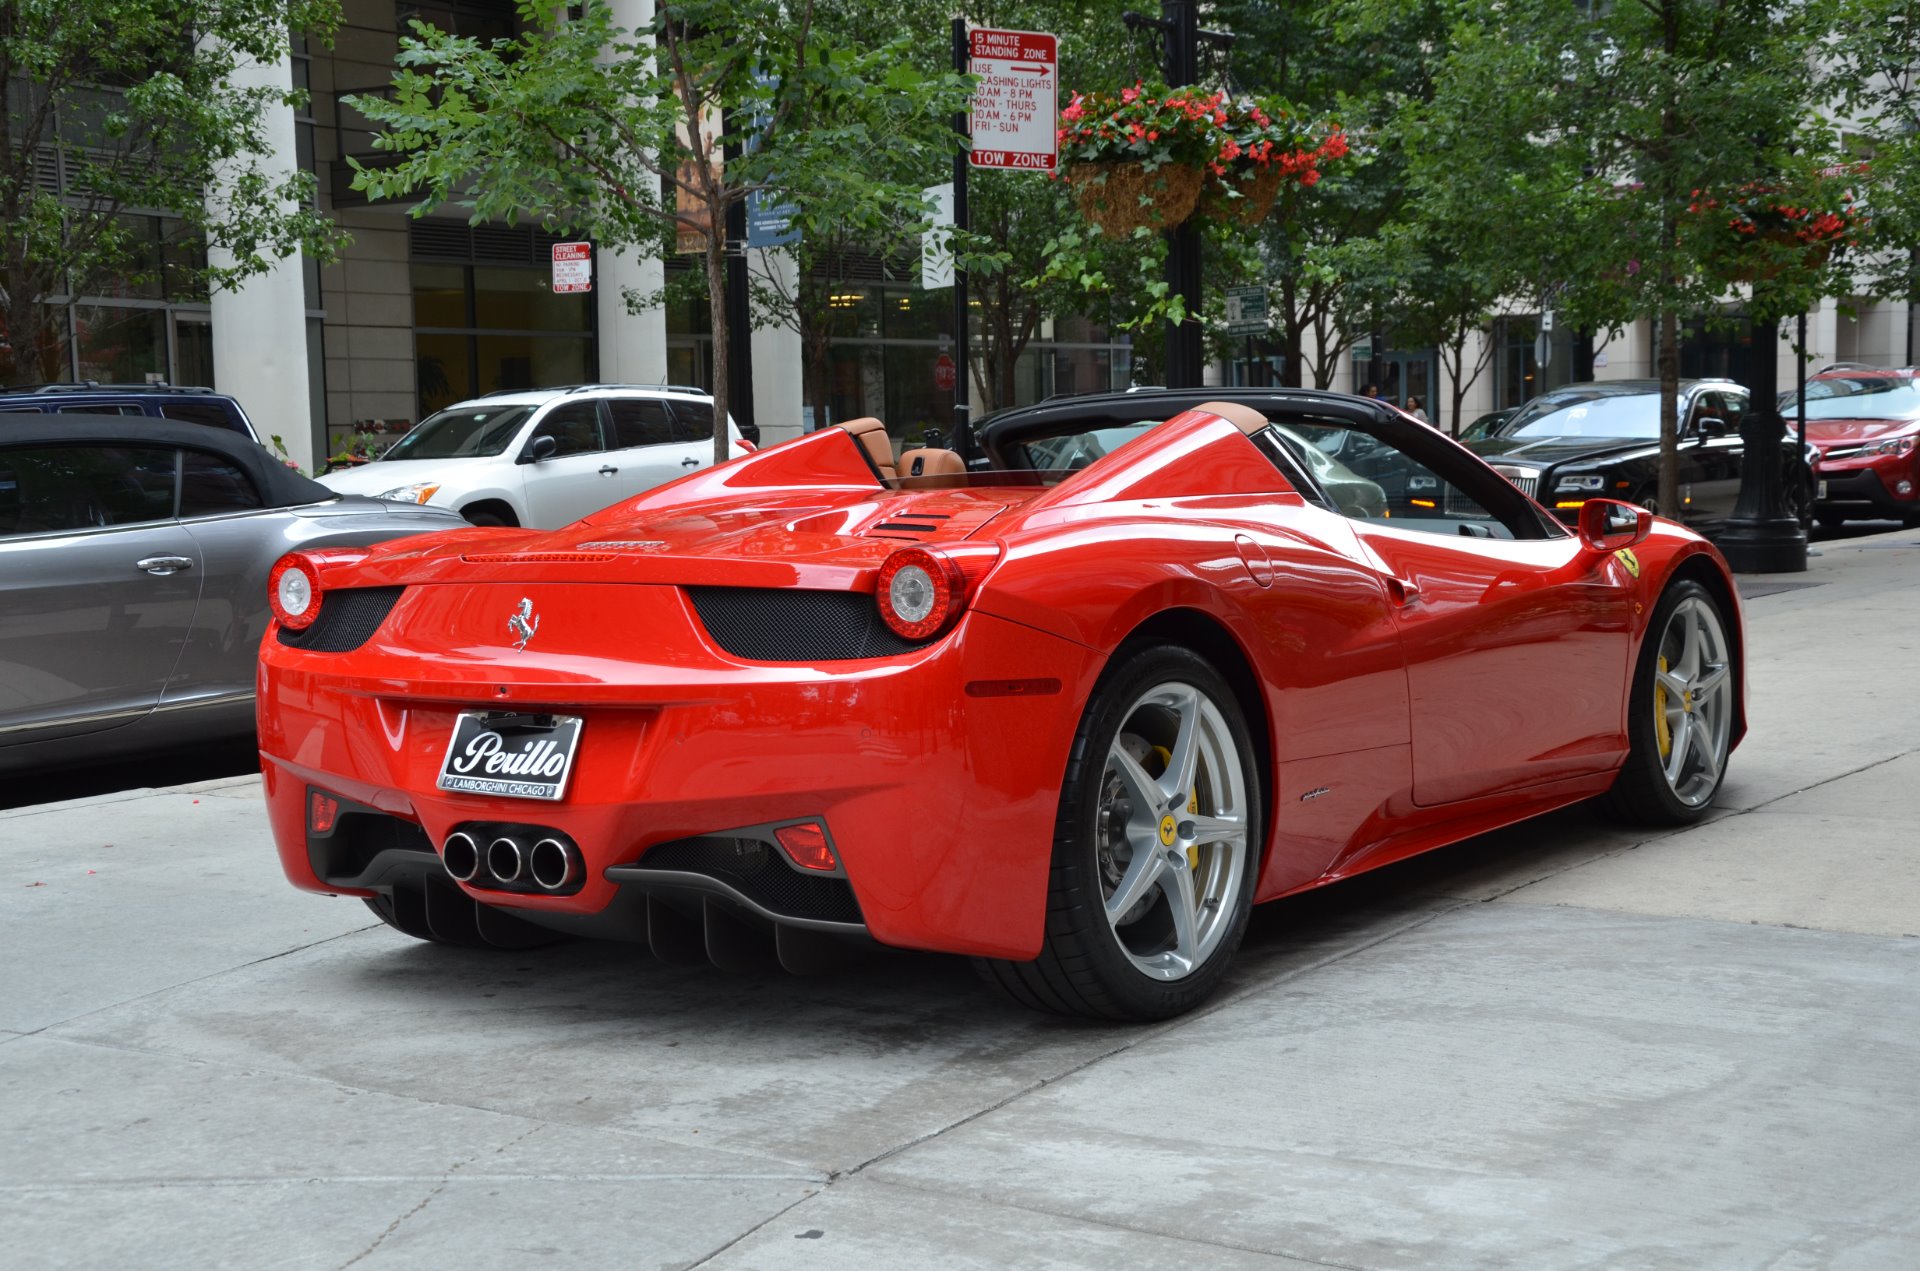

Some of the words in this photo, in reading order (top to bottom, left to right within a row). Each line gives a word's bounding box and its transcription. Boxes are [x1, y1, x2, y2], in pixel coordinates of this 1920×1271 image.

[975, 33, 984, 44] 15
[987, 35, 1020, 46] MINUTE
[975, 45, 1019, 58] STANDING
[1024, 49, 1047, 60] ZONE
[975, 64, 992, 74] USE
[979, 77, 1019, 88] LASHING
[1021, 79, 1051, 89] LIGHTS
[976, 87, 985, 96] 10
[987, 88, 1000, 97] AM
[1010, 89, 1016, 98] 8
[1019, 90, 1032, 99] PM
[975, 99, 995, 108] MON
[1006, 100, 1036, 111] THURS
[975, 110, 984, 119] 10
[986, 111, 1000, 120] AM
[1010, 112, 1016, 121] 6
[1018, 112, 1031, 122] PM
[975, 121, 990, 131] FRI
[1000, 123, 1019, 132] SUN
[976, 151, 1004, 165] TOW
[1013, 154, 1049, 167] ZONE
[556, 252, 586, 260] CLEANING
[453, 731, 566, 777] Perillo
[453, 778, 507, 793] LAMBORGHINI
[509, 784, 545, 796] CHICAGO
